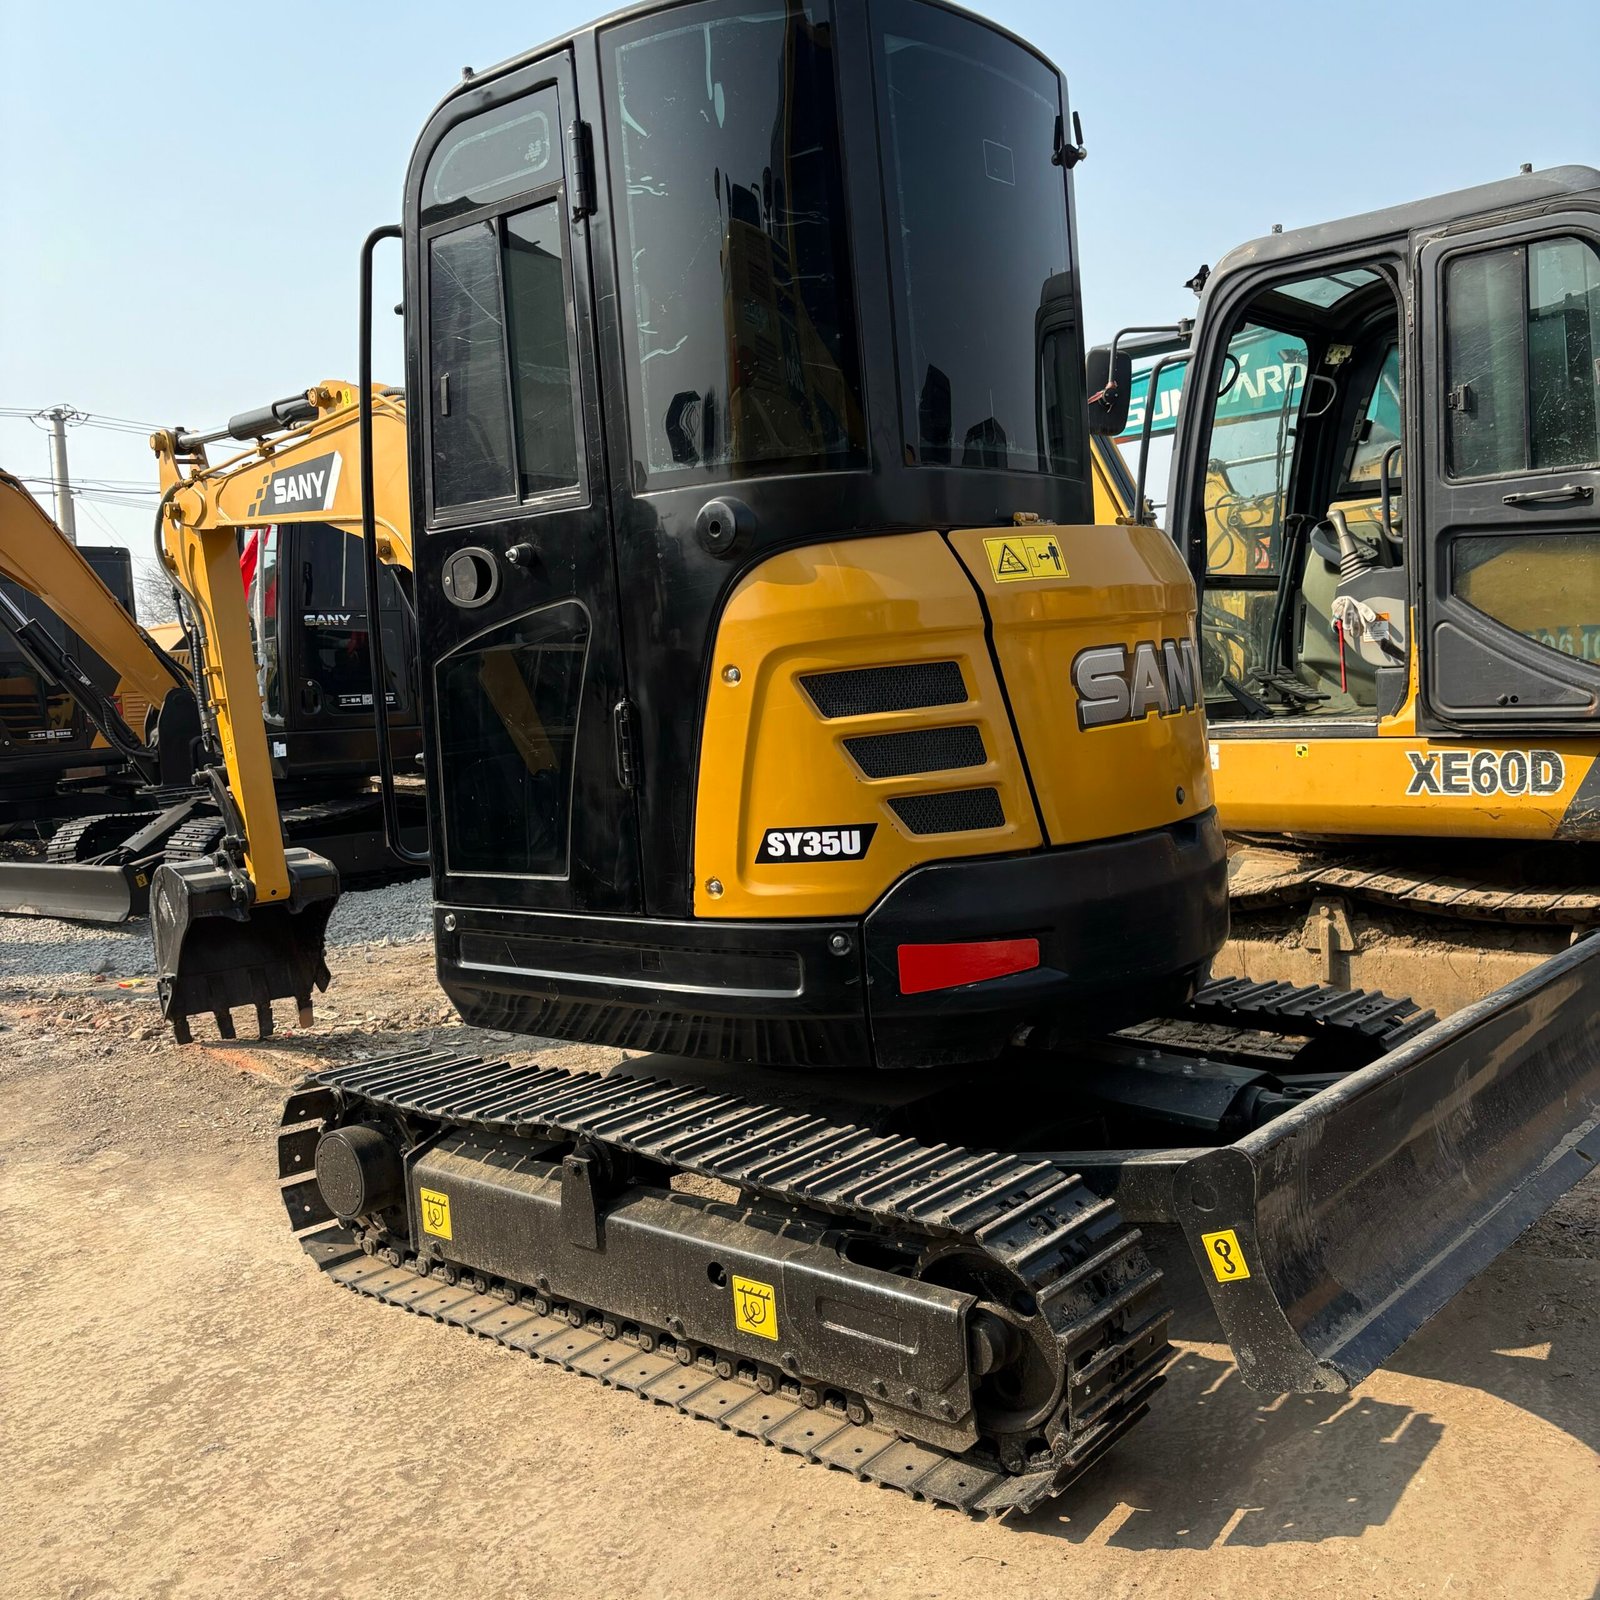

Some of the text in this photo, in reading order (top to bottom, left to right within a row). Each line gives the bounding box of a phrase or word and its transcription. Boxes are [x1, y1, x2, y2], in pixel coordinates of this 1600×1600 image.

[274, 470, 325, 504] SANY
[303, 614, 351, 626] SANY
[1405, 749, 1565, 797] XE60D
[767, 830, 861, 857] SY35U
